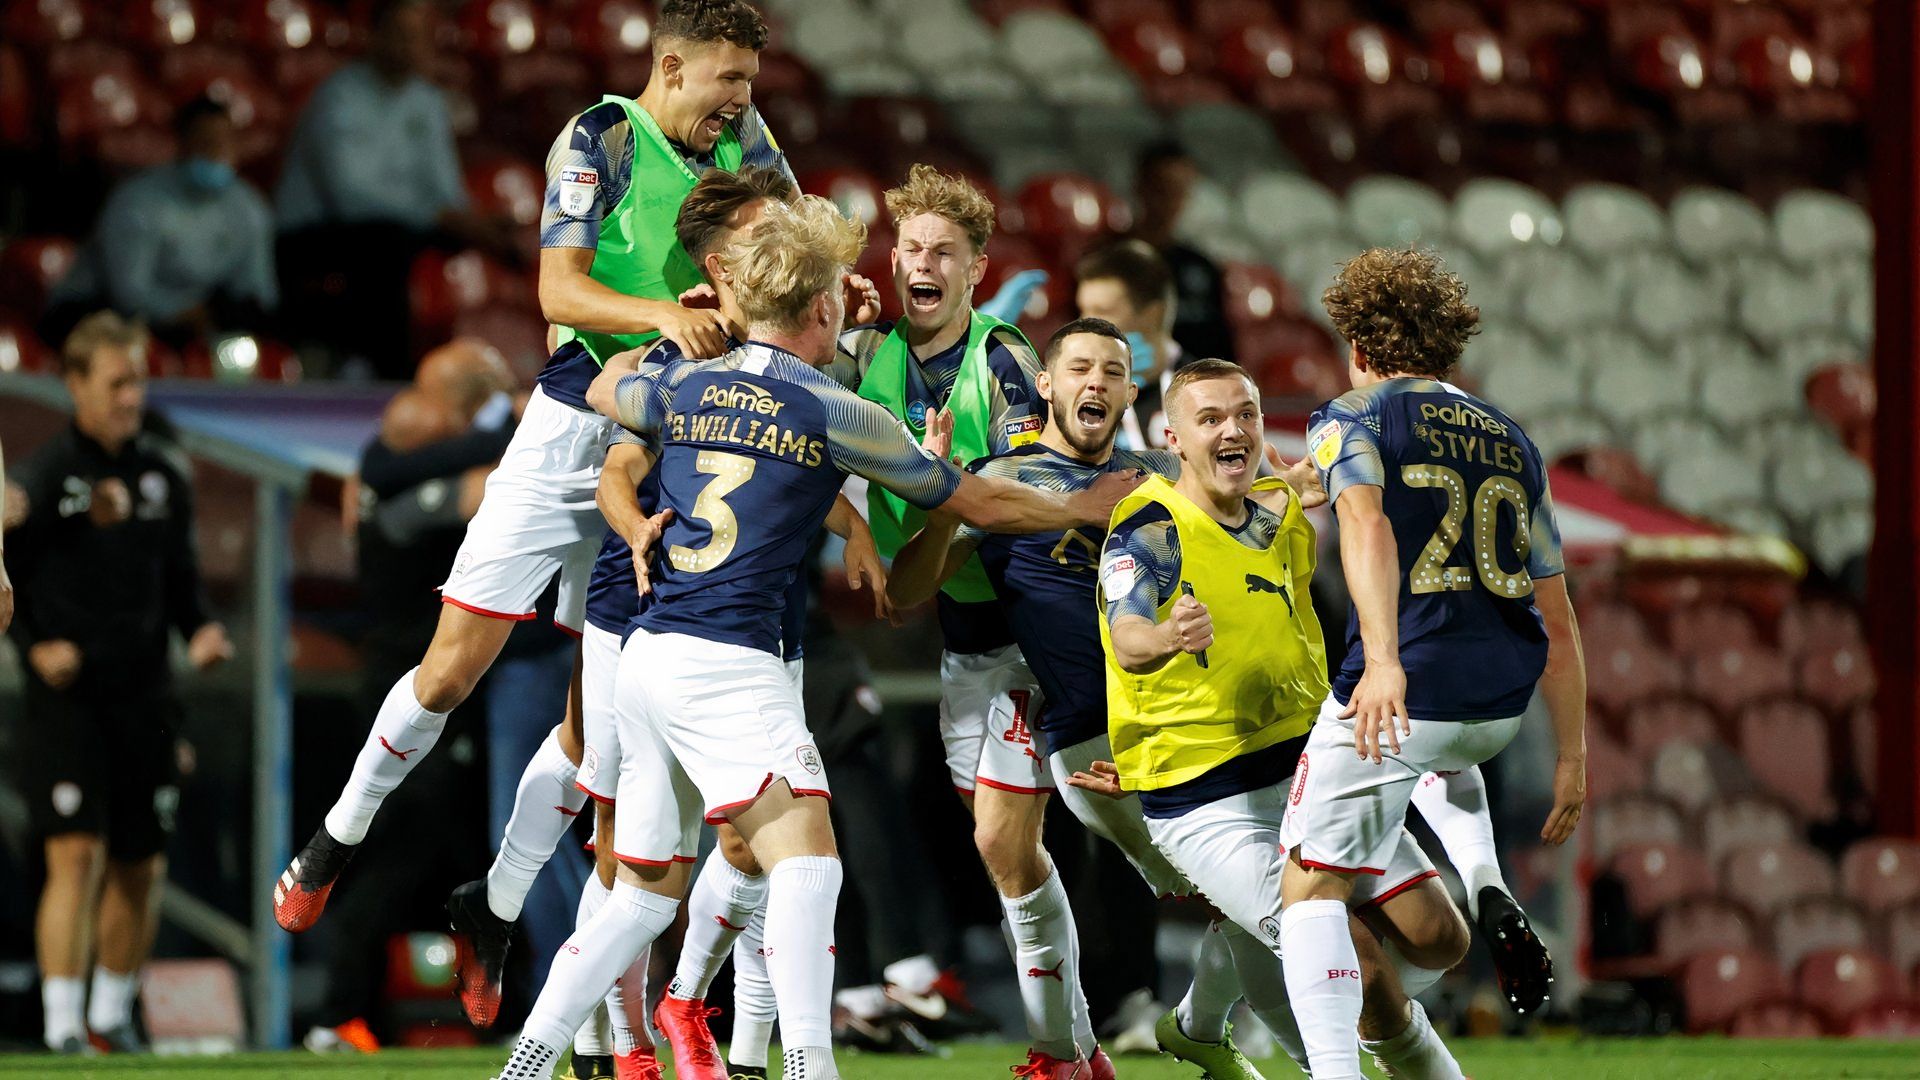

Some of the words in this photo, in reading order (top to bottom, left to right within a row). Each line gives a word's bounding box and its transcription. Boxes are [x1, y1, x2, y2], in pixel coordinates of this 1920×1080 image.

[562, 171, 578, 182] sky
[579, 172, 596, 183] bet
[671, 413, 825, 468] B.WILLIAMS
[1007, 422, 1022, 433] sky
[1023, 420, 1039, 430] bet
[1428, 428, 1524, 474] STYLES
[668, 450, 757, 573] 3
[1400, 463, 1534, 599] 20
[1115, 560, 1134, 570] bet
[1327, 969, 1360, 980] BFC
